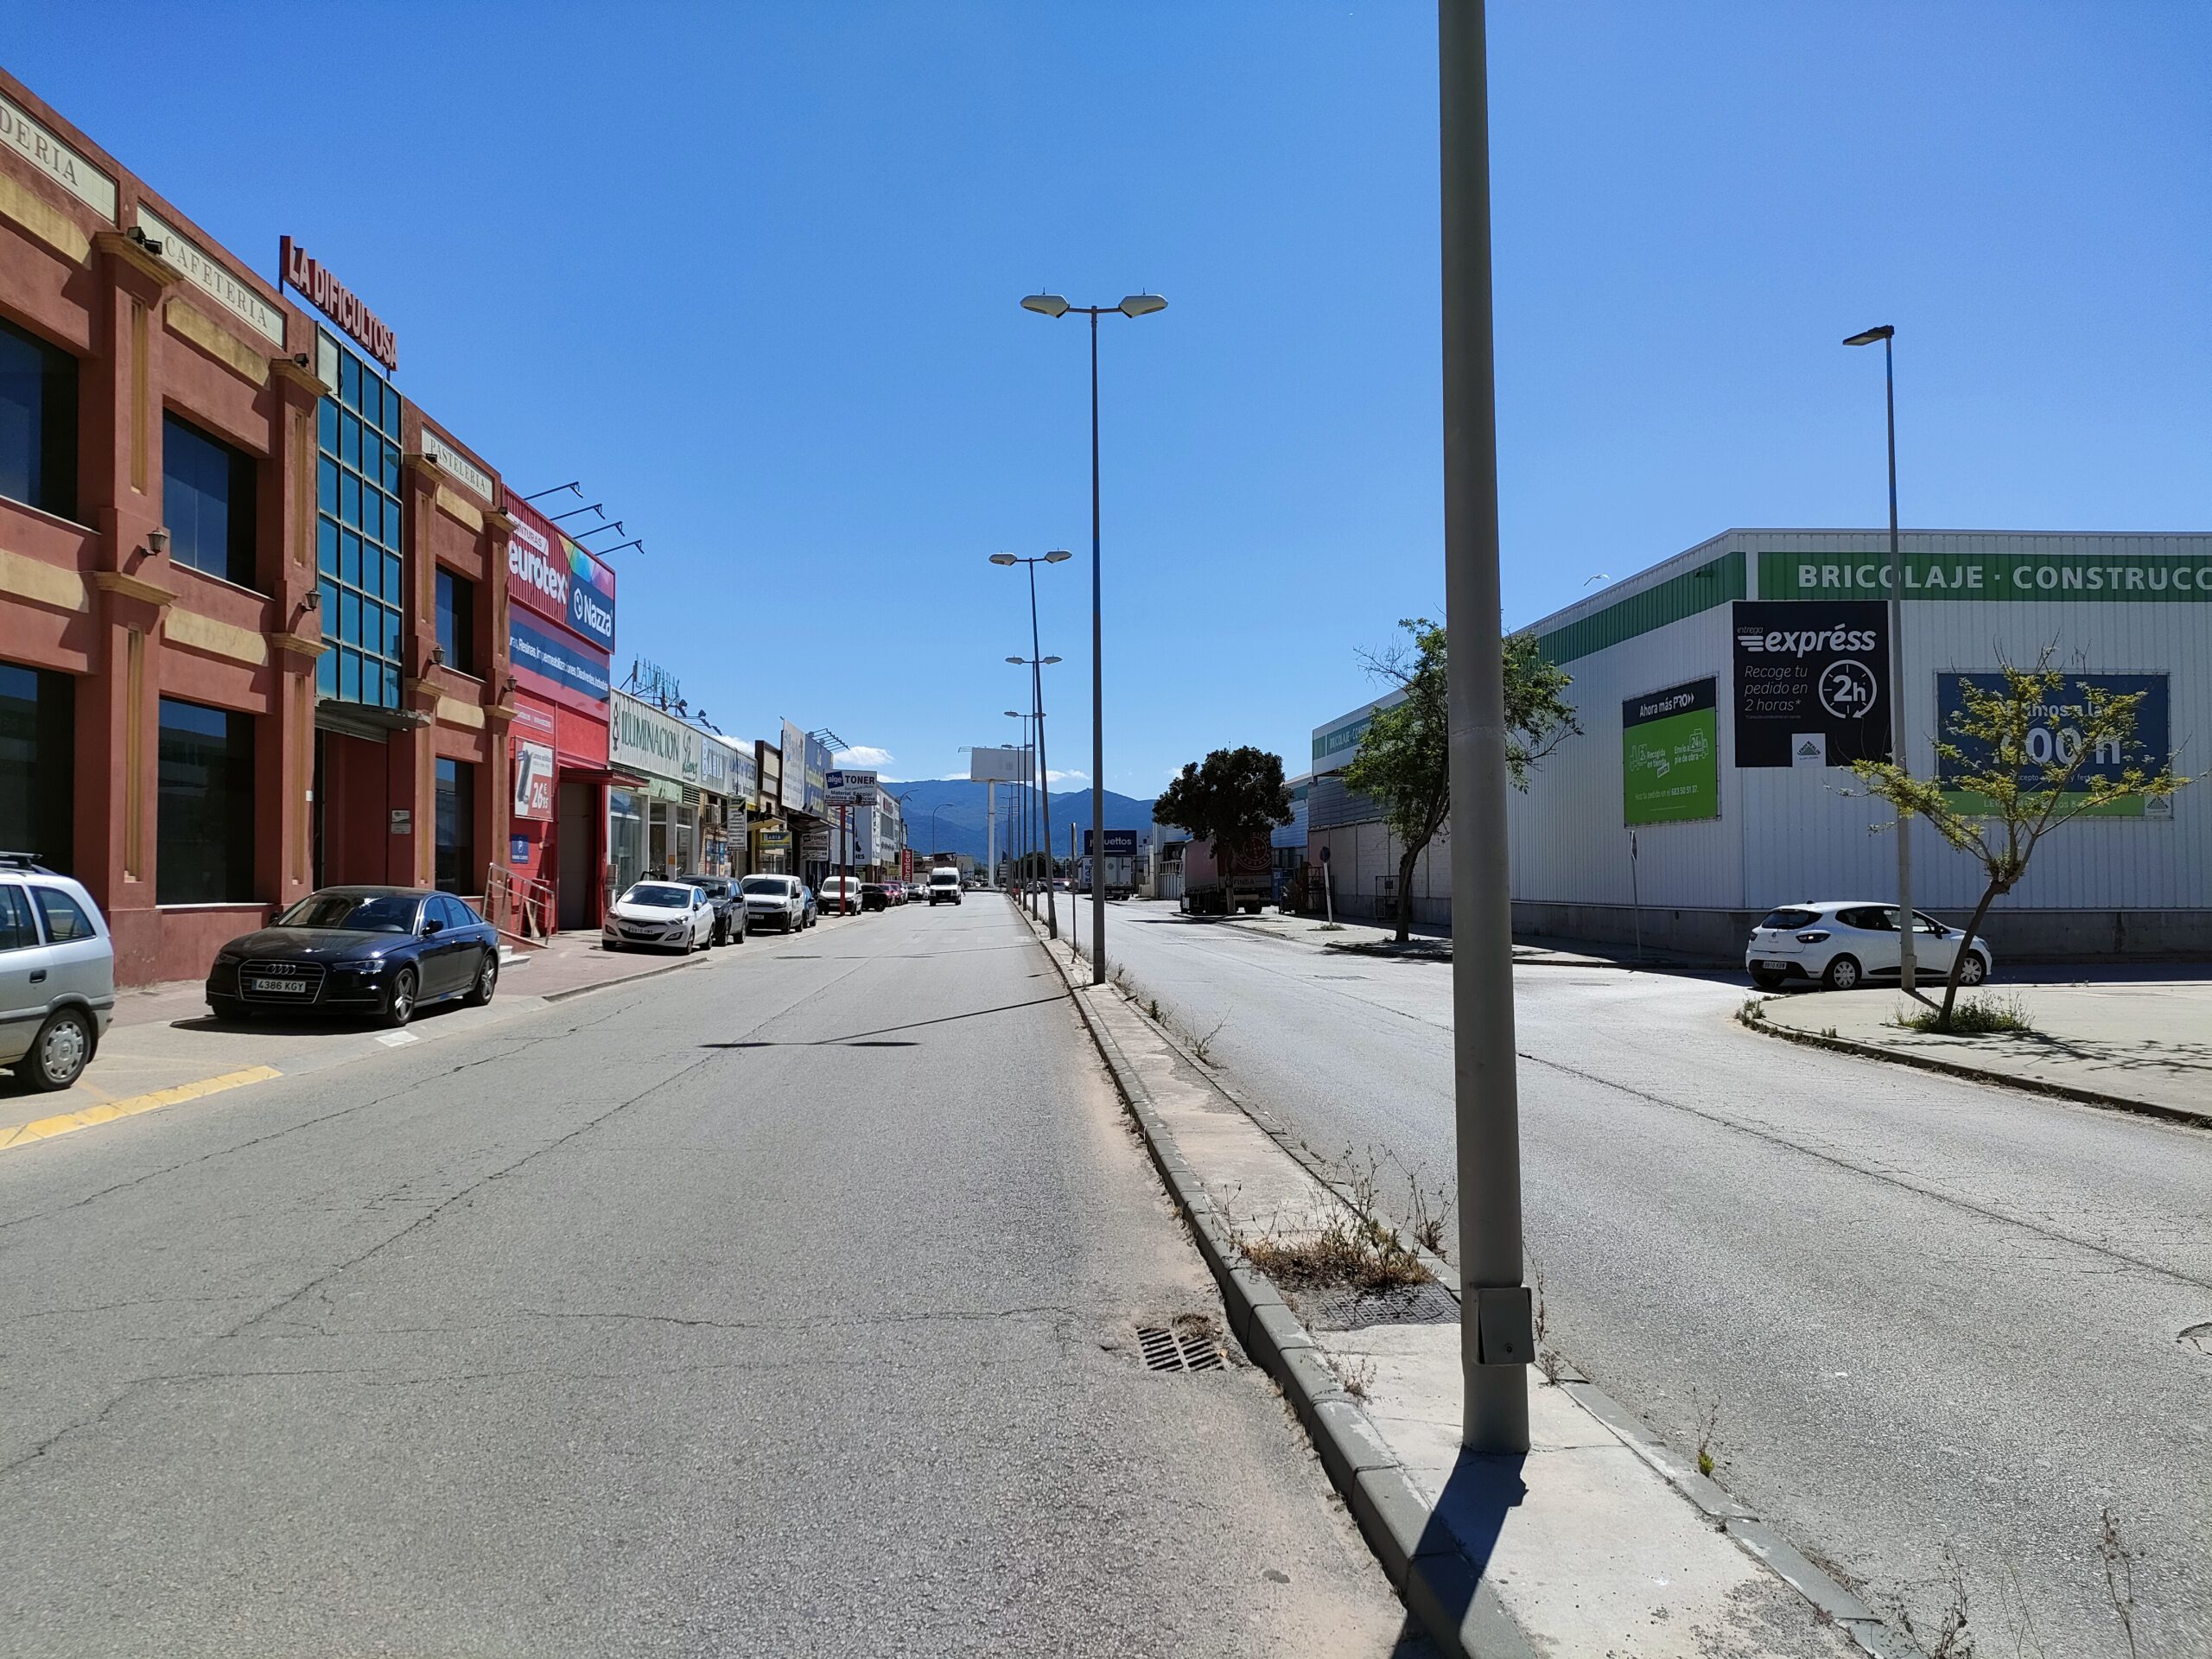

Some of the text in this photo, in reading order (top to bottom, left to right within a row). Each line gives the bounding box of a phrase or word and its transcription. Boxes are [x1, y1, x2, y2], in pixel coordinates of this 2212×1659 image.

[165, 235, 269, 328] CAFETERIA
[287, 235, 397, 372] LA DIFICULTOSA
[430, 439, 486, 493] PASTELERIA
[508, 539, 567, 605] eurotex
[1798, 564, 2212, 590] BRICOLAJE CONSTRUCC
[583, 594, 612, 638] Nazza
[1737, 626, 1764, 635] entrega
[1764, 623, 1877, 658] expréss
[1745, 665, 1808, 679] Recoge tu
[1744, 682, 1808, 696] pedido en
[1639, 693, 1688, 718] Ahora más PRO
[1745, 699, 1754, 711] 2
[621, 710, 679, 762] ILUMINACION
[1796, 741, 1821, 755] LEROY MERLIN
[1688, 753, 1699, 761] obra
[844, 774, 875, 785] TONER
[531, 782, 543, 810] 26
[1089, 836, 1132, 848] juettos
[257, 980, 304, 991] 4386 KGY
